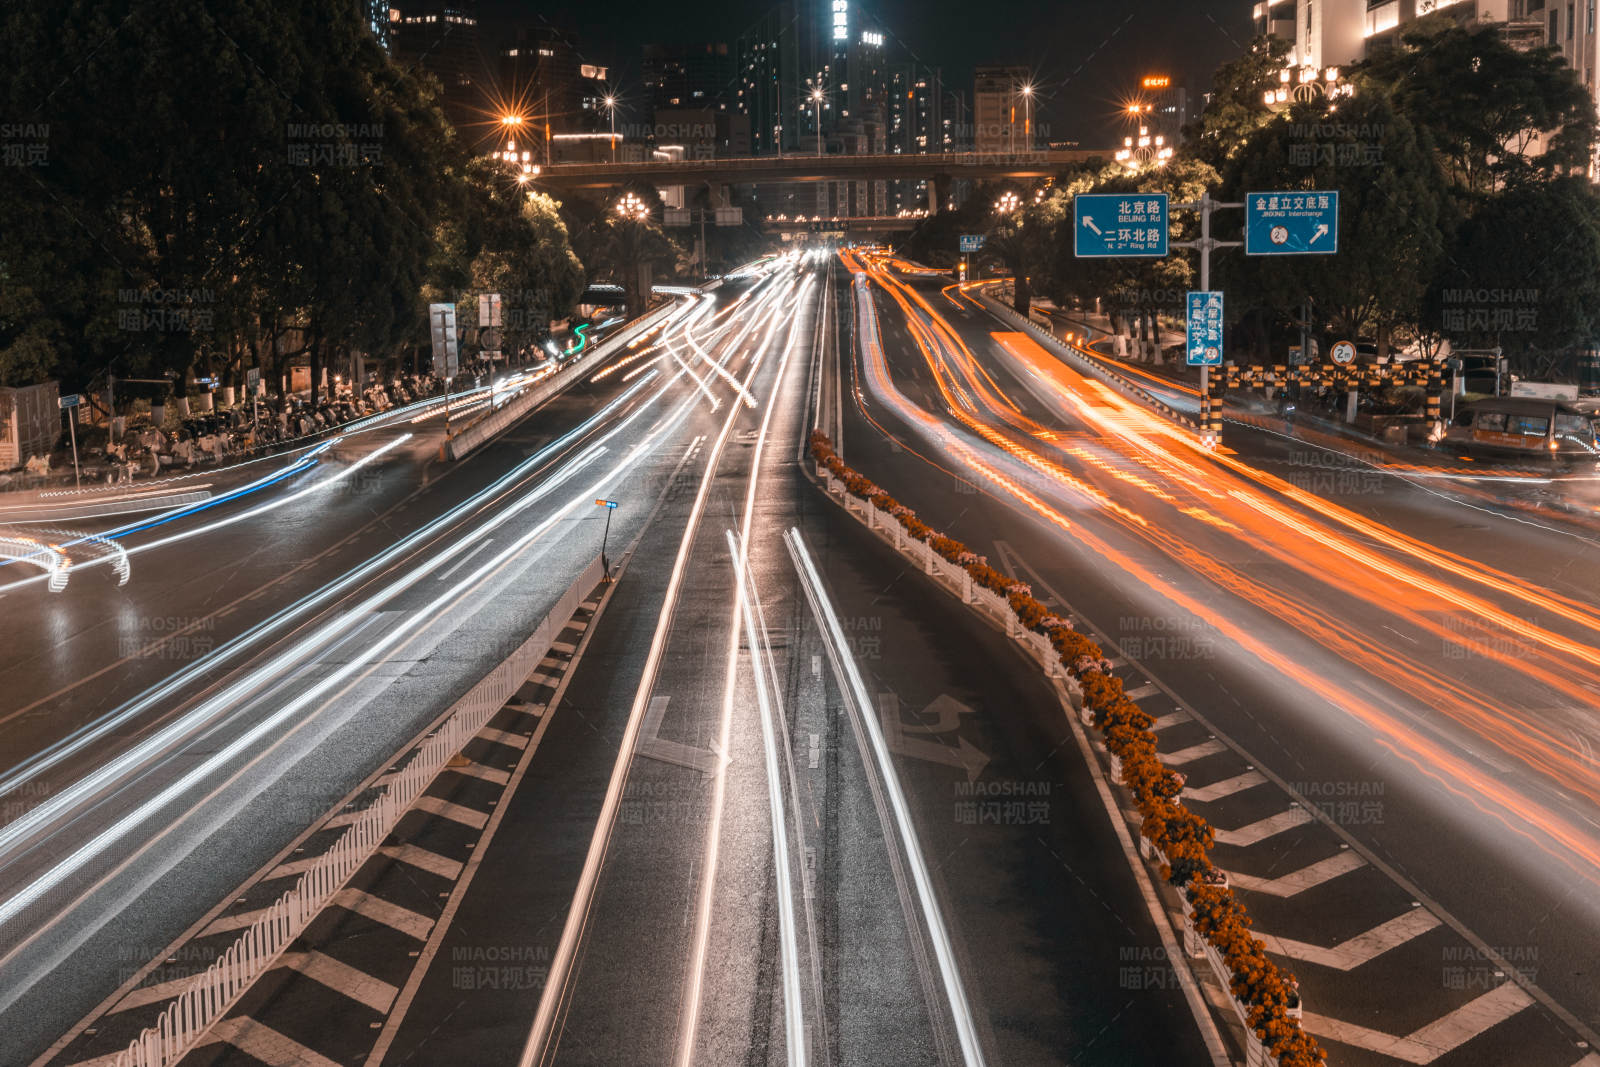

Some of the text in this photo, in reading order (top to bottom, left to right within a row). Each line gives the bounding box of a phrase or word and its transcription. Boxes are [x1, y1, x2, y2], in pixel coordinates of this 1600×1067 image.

[1119, 200, 1160, 214] 北京路
[1256, 196, 1329, 211] 金星立交底层
[1104, 228, 1160, 242] 二环北路
[1191, 297, 1202, 341] 金星立交
[1336, 348, 1351, 359] 2m
